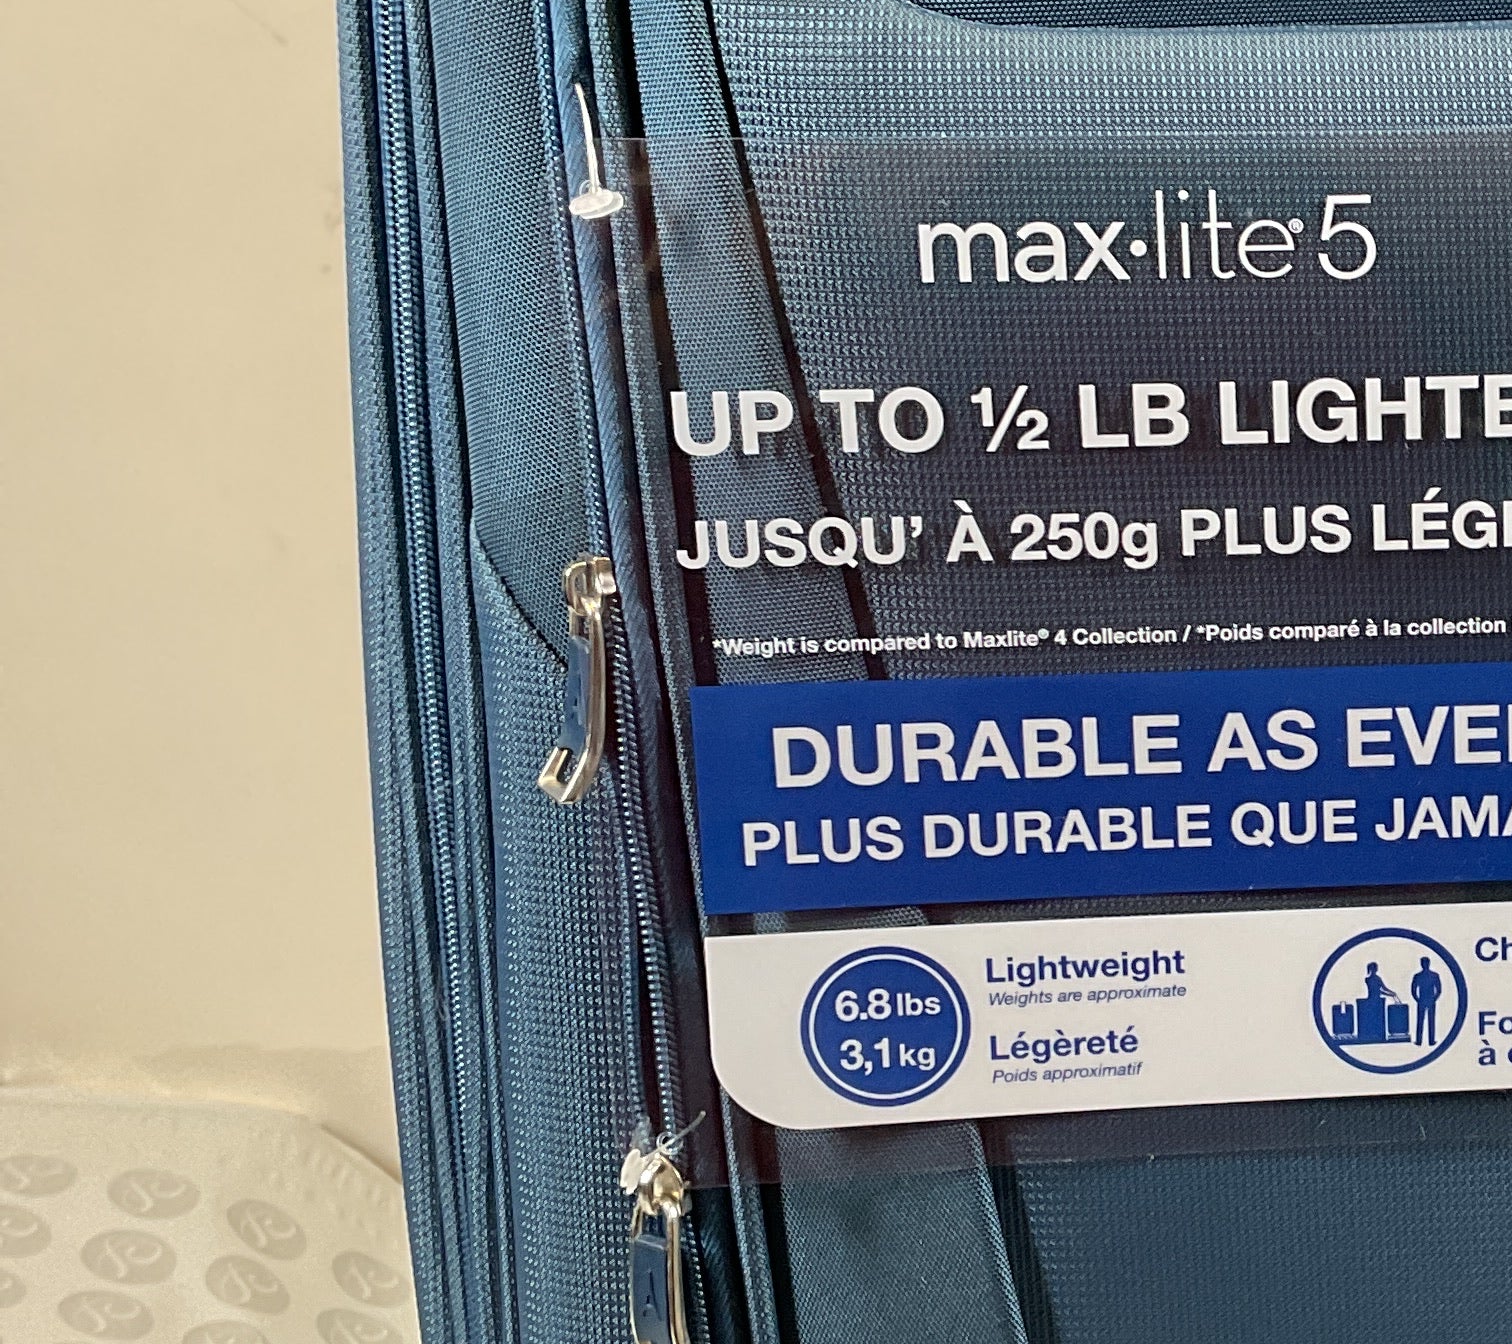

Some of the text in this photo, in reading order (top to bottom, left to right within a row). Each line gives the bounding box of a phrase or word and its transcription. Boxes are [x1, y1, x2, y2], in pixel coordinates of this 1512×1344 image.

[670, 389, 794, 457] UP
[819, 386, 945, 454] TO
[1078, 382, 1189, 449] LB
[946, 500, 995, 563] À
[1009, 512, 1159, 570] 250g
[1181, 504, 1352, 557] PLUS
[800, 637, 818, 653] is
[823, 635, 930, 656] compared
[935, 634, 958, 649] to
[1053, 629, 1067, 646] 4
[1071, 627, 1178, 645] Collection
[1182, 626, 1191, 643] /
[1269, 621, 1361, 644] comparé
[1366, 619, 1379, 637] à
[1383, 620, 1401, 636] la
[1406, 618, 1506, 636] collection
[772, 713, 1183, 788] DURABLE
[1206, 709, 1318, 772] AS
[742, 816, 904, 867] PLUS
[922, 804, 1213, 858] DURABLE
[1230, 799, 1357, 848] QUE
[986, 950, 1186, 988] Lightweight
[988, 984, 1186, 1008] Weights are approximate
[990, 1026, 1139, 1063] Légèreté
[1478, 1040, 1496, 1066] à
[992, 1062, 1144, 1083] Poids approximatif
